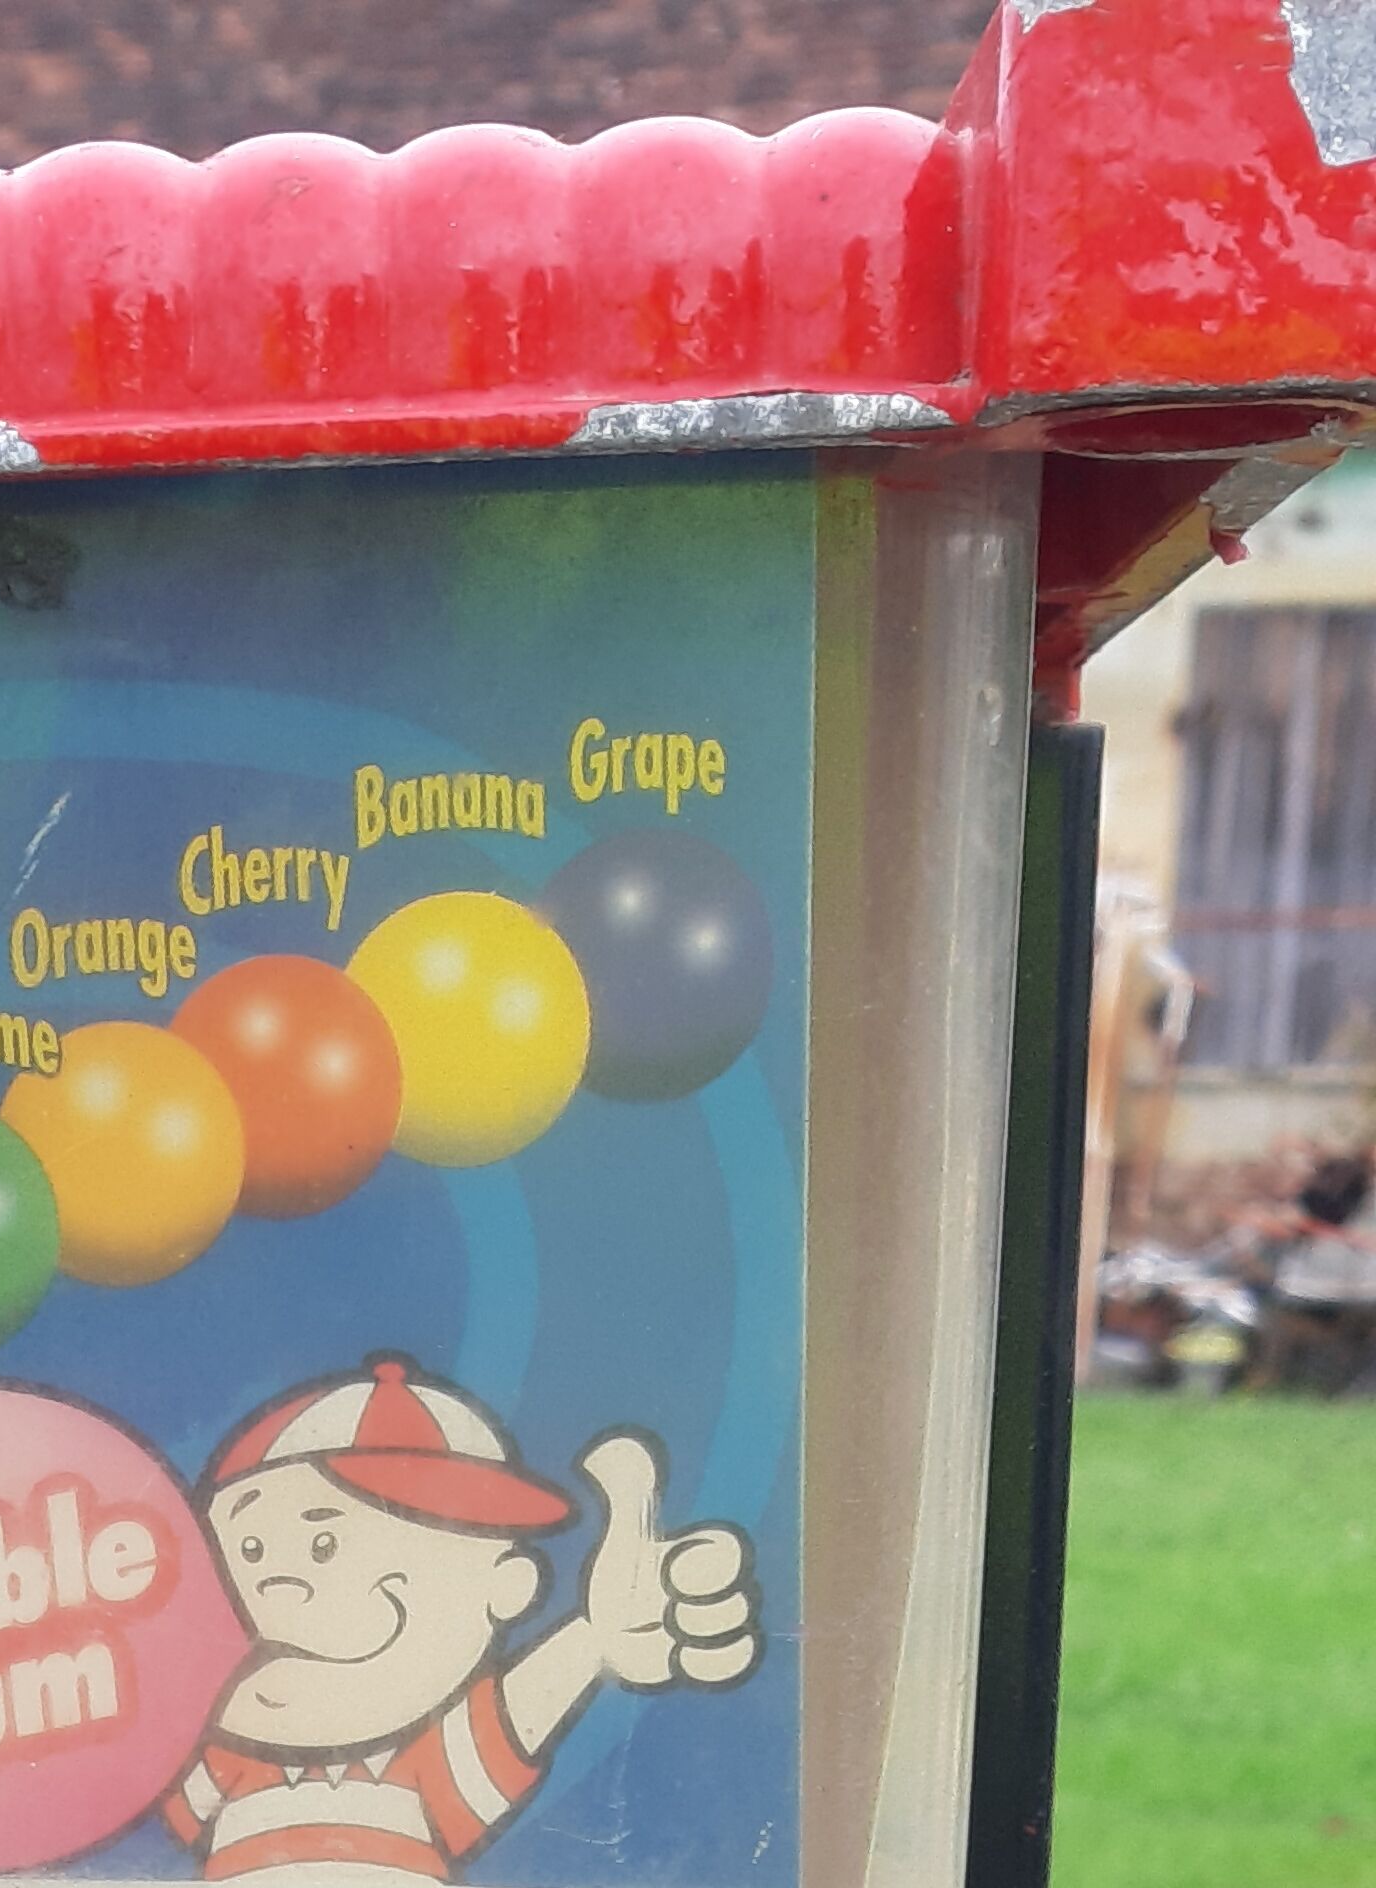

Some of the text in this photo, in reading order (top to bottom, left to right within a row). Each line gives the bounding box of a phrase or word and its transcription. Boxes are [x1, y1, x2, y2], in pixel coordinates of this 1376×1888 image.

[355, 763, 546, 848] Banana
[569, 718, 726, 814] Grape
[179, 826, 349, 929] Cherry
[11, 908, 197, 998] Orange
